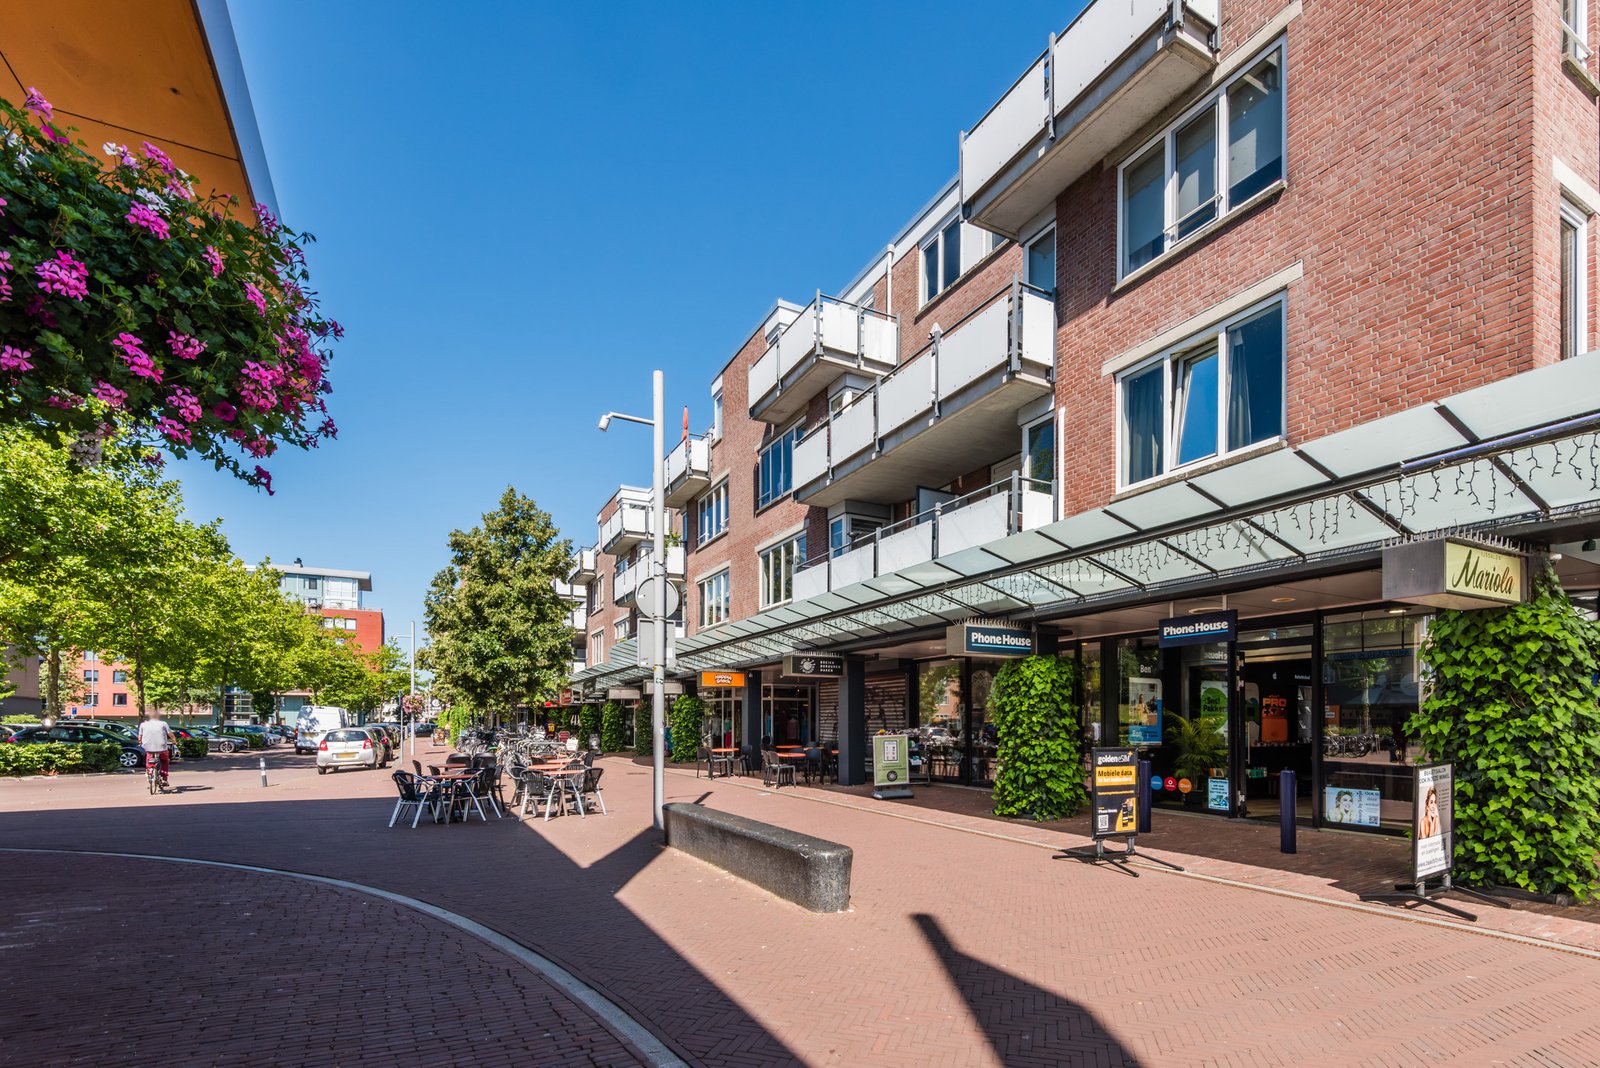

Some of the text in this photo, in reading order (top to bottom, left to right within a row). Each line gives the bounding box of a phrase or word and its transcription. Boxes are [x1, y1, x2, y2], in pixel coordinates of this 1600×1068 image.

[1452, 549, 1514, 594] Mariola
[1163, 621, 1229, 636] Phone House
[971, 632, 1031, 646] Phone House
[1263, 697, 1287, 707] PRO
